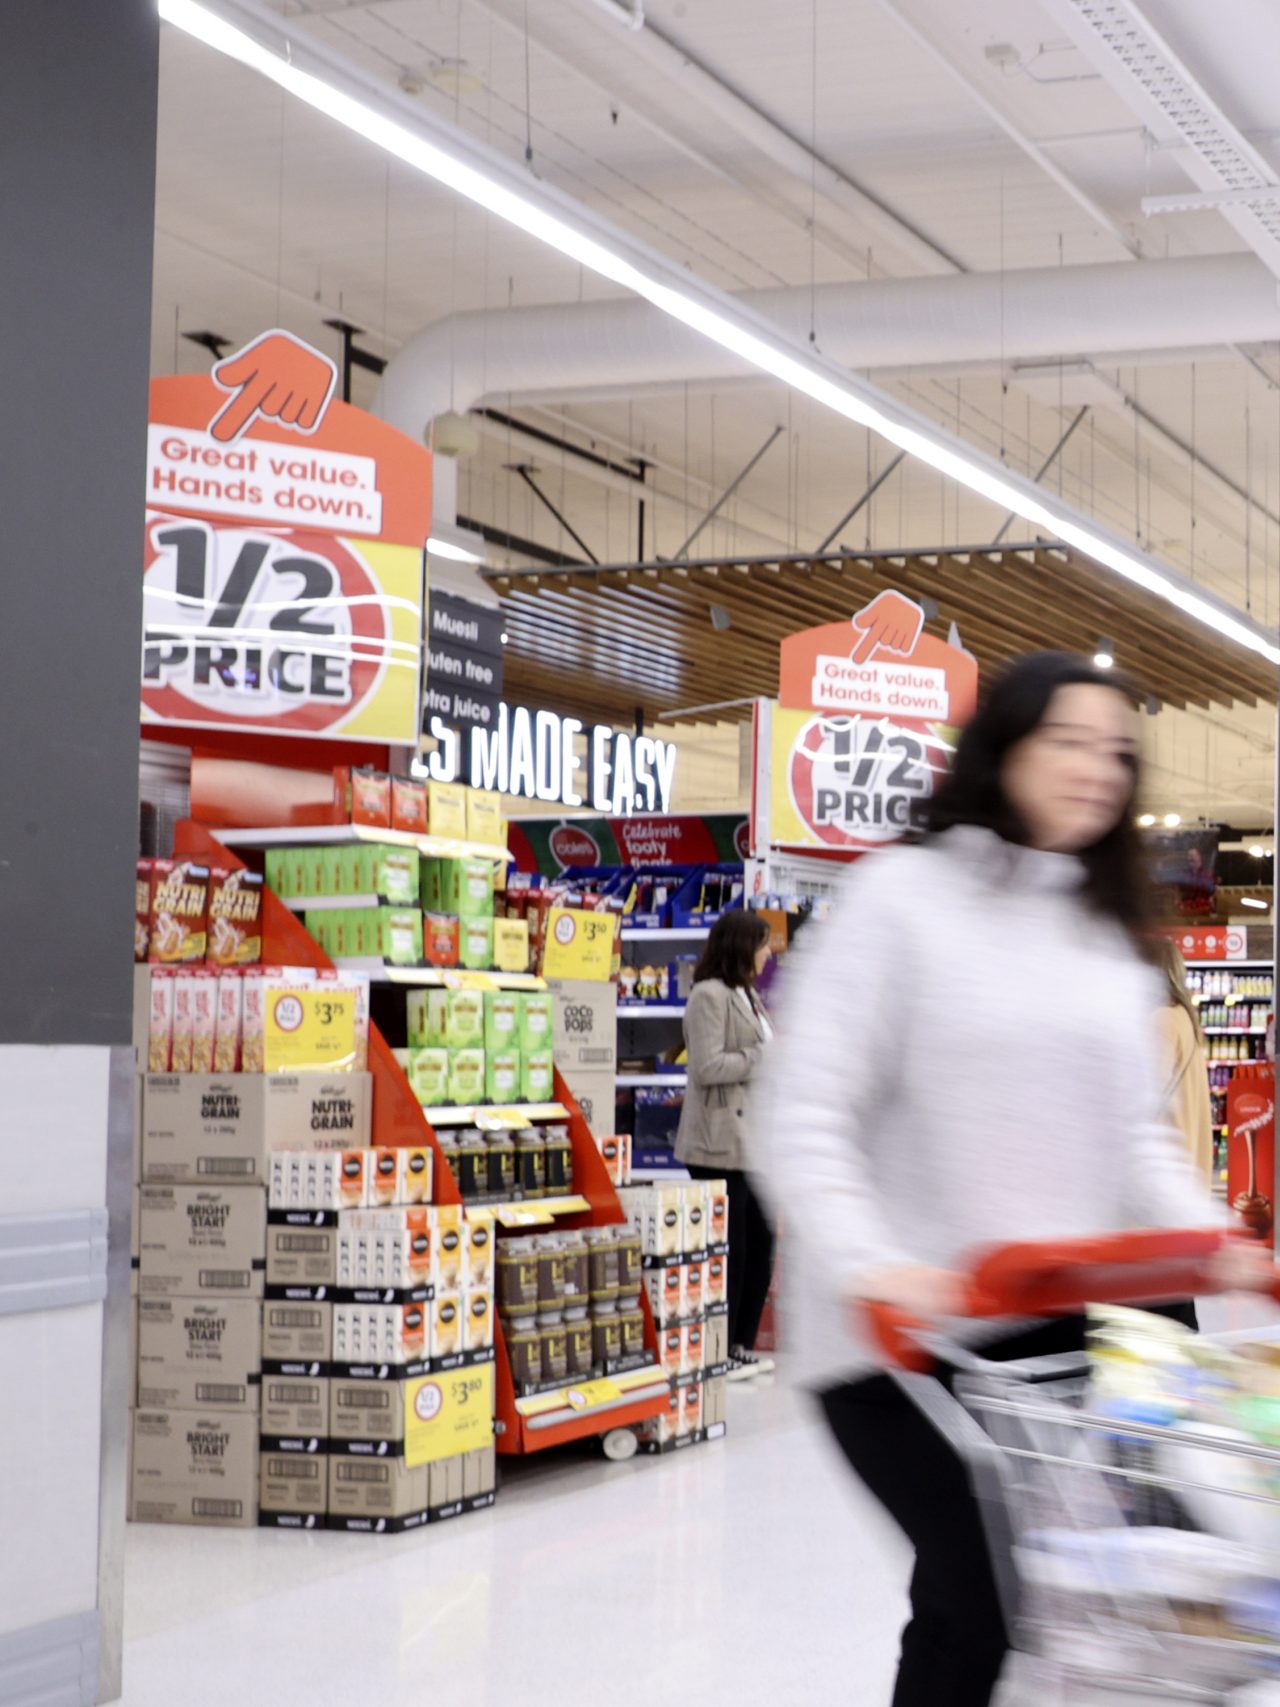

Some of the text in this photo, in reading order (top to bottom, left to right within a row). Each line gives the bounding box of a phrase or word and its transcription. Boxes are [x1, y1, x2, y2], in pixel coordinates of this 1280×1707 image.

[160, 436, 367, 490] Great value.
[152, 467, 373, 520] Hands down.
[157, 526, 336, 635] 1/2
[433, 610, 479, 641] Muesli
[143, 631, 347, 698] PRICE
[465, 659, 493, 684] free
[824, 663, 940, 691] Great value.
[424, 688, 490, 722] tra juice
[820, 683, 944, 711] Hands down.
[471, 702, 582, 807] MADE
[593, 724, 677, 817] EASY
[822, 719, 924, 790] 1/2
[622, 822, 683, 839] Celebrate
[626, 838, 668, 855] footy
[201, 1107, 240, 1119] GRAIN
[311, 1115, 353, 1130] GRAIN
[187, 1205, 230, 1216] BRIGHT
[192, 1216, 225, 1228] START
[184, 1318, 226, 1330] BRIGHT
[188, 1329, 222, 1341] START
[187, 1432, 230, 1445] BRIGHT
[192, 1444, 225, 1456] START
